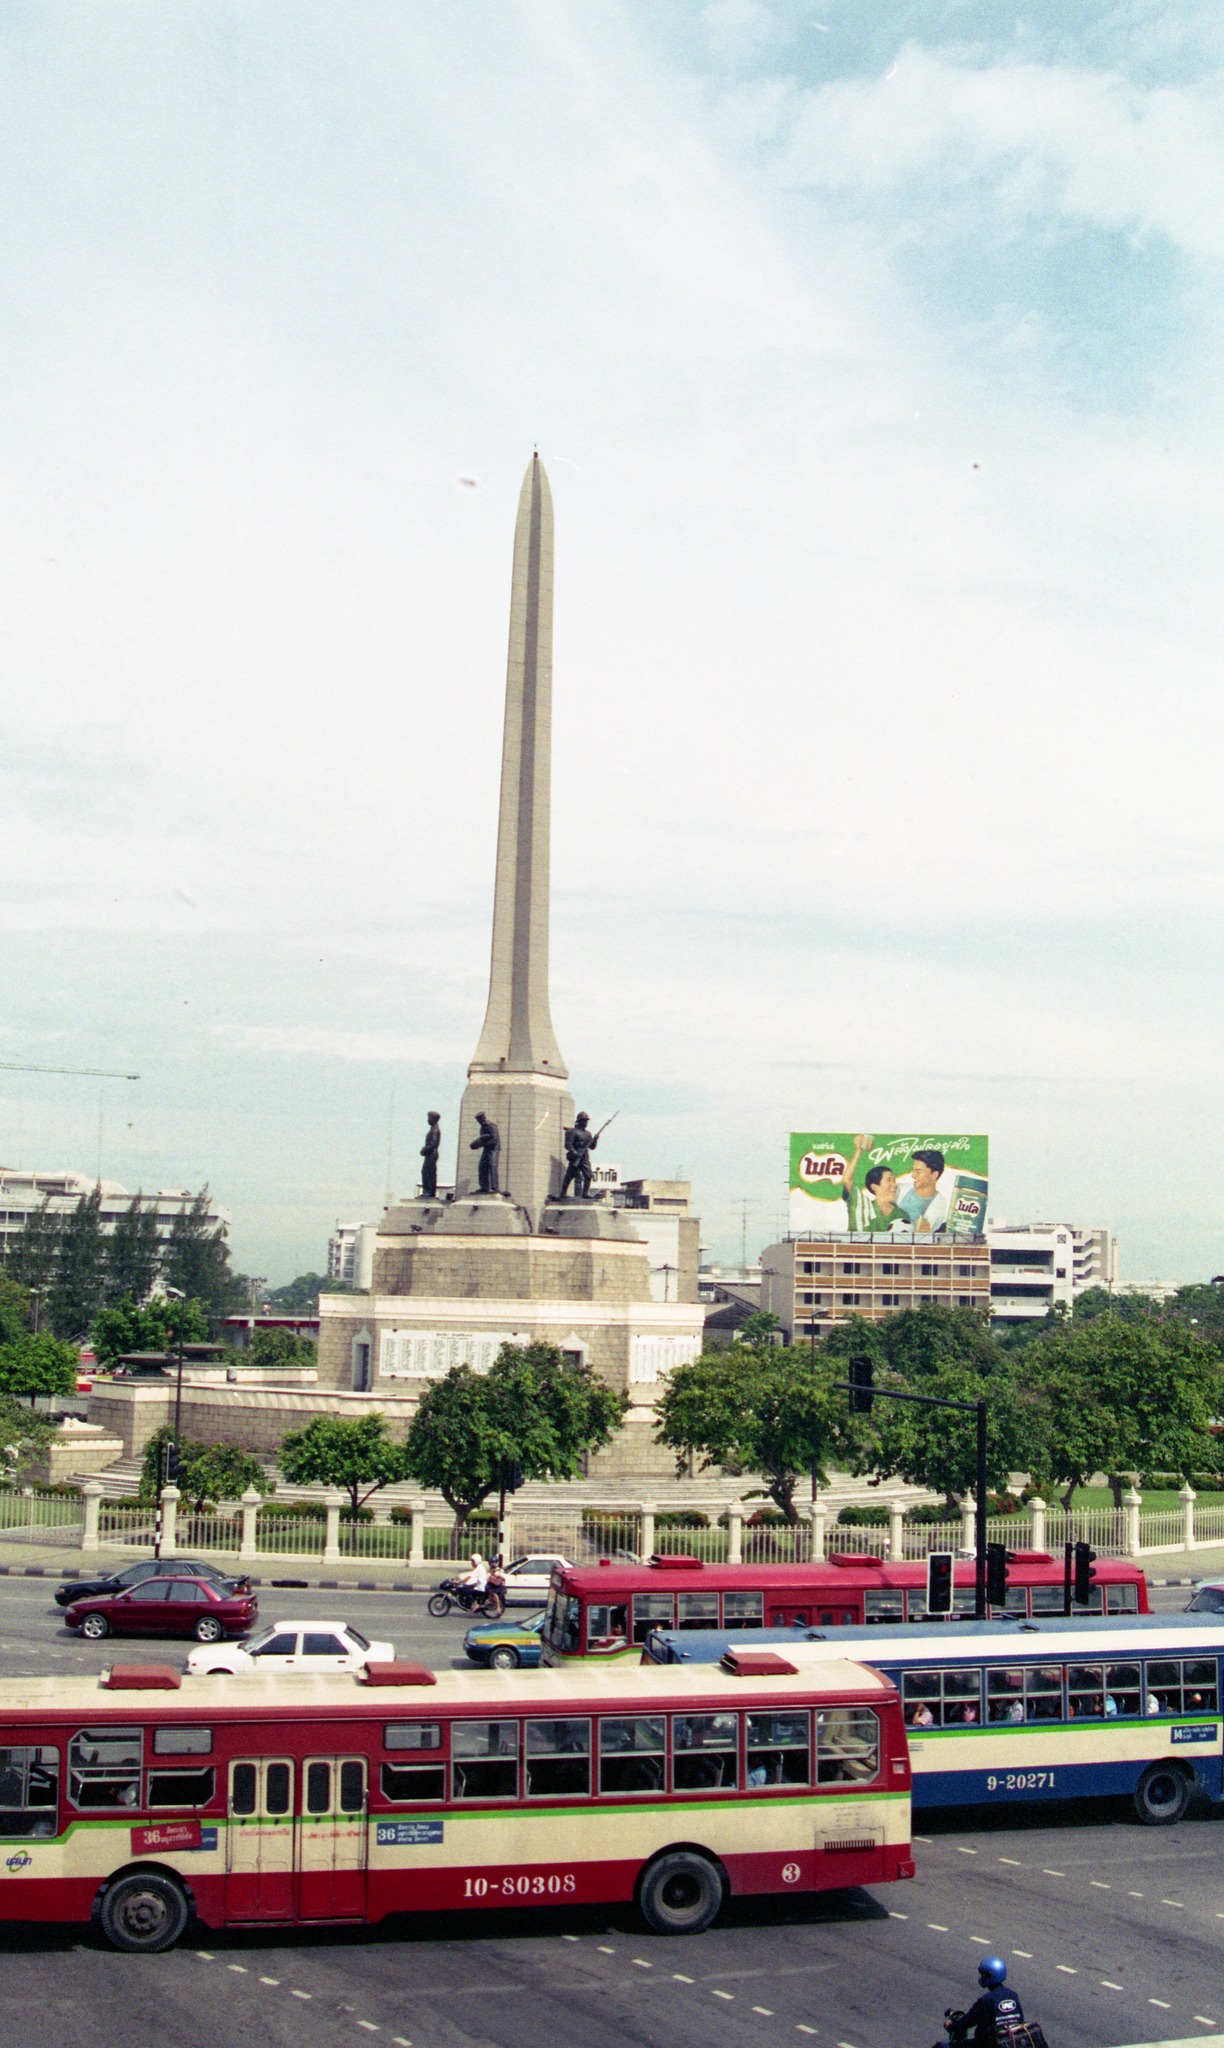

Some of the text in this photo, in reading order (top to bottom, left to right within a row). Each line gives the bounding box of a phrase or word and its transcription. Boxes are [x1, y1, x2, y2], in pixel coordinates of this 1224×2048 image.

[804, 1157, 845, 1176] ไมโล
[958, 1199, 979, 1215] ไมโล
[987, 1771, 1055, 1791] 9-20271
[143, 1830, 161, 1845] 36
[378, 1828, 396, 1841] 36
[785, 1865, 798, 1881] 3
[464, 1874, 577, 1897] 10-80308
